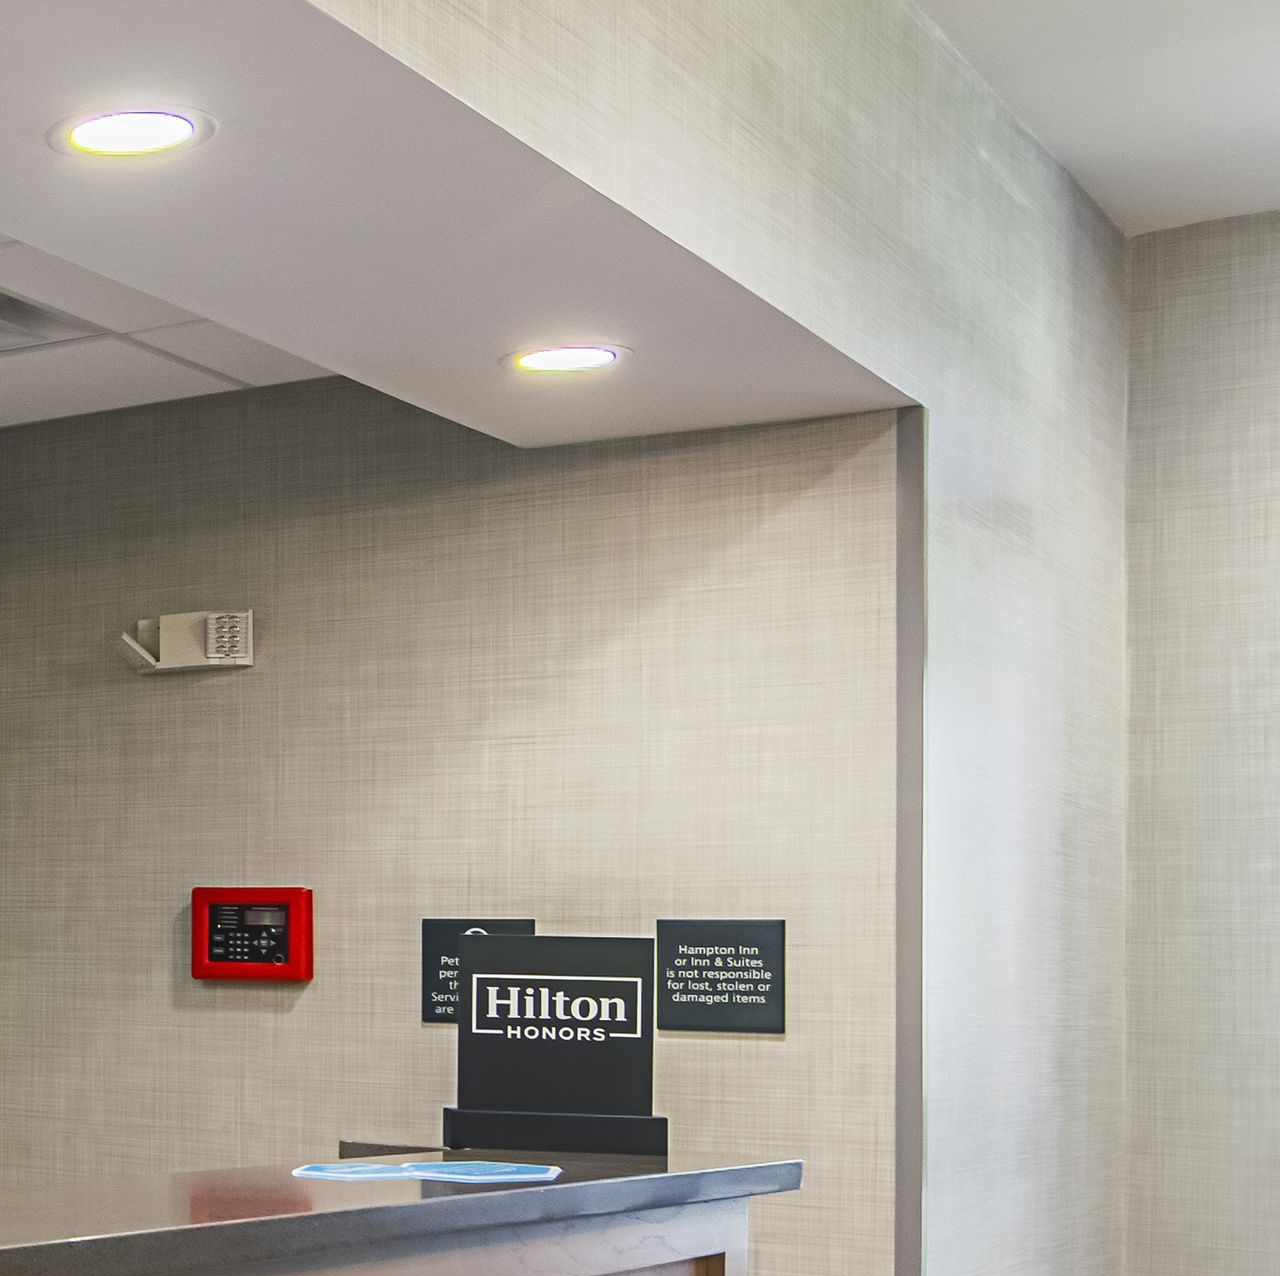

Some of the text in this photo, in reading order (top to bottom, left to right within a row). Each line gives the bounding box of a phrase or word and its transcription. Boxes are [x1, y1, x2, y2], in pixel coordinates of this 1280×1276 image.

[678, 945, 759, 957] Hampton Inn
[674, 957, 764, 967] or Inn & Suites
[666, 968, 772, 980] is not responsible
[667, 979, 771, 992] for lost, stolen or
[486, 986, 628, 1022] Hilton
[672, 992, 766, 1005] damaged items
[434, 1006, 454, 1014] are
[507, 1025, 606, 1042] HONORS
